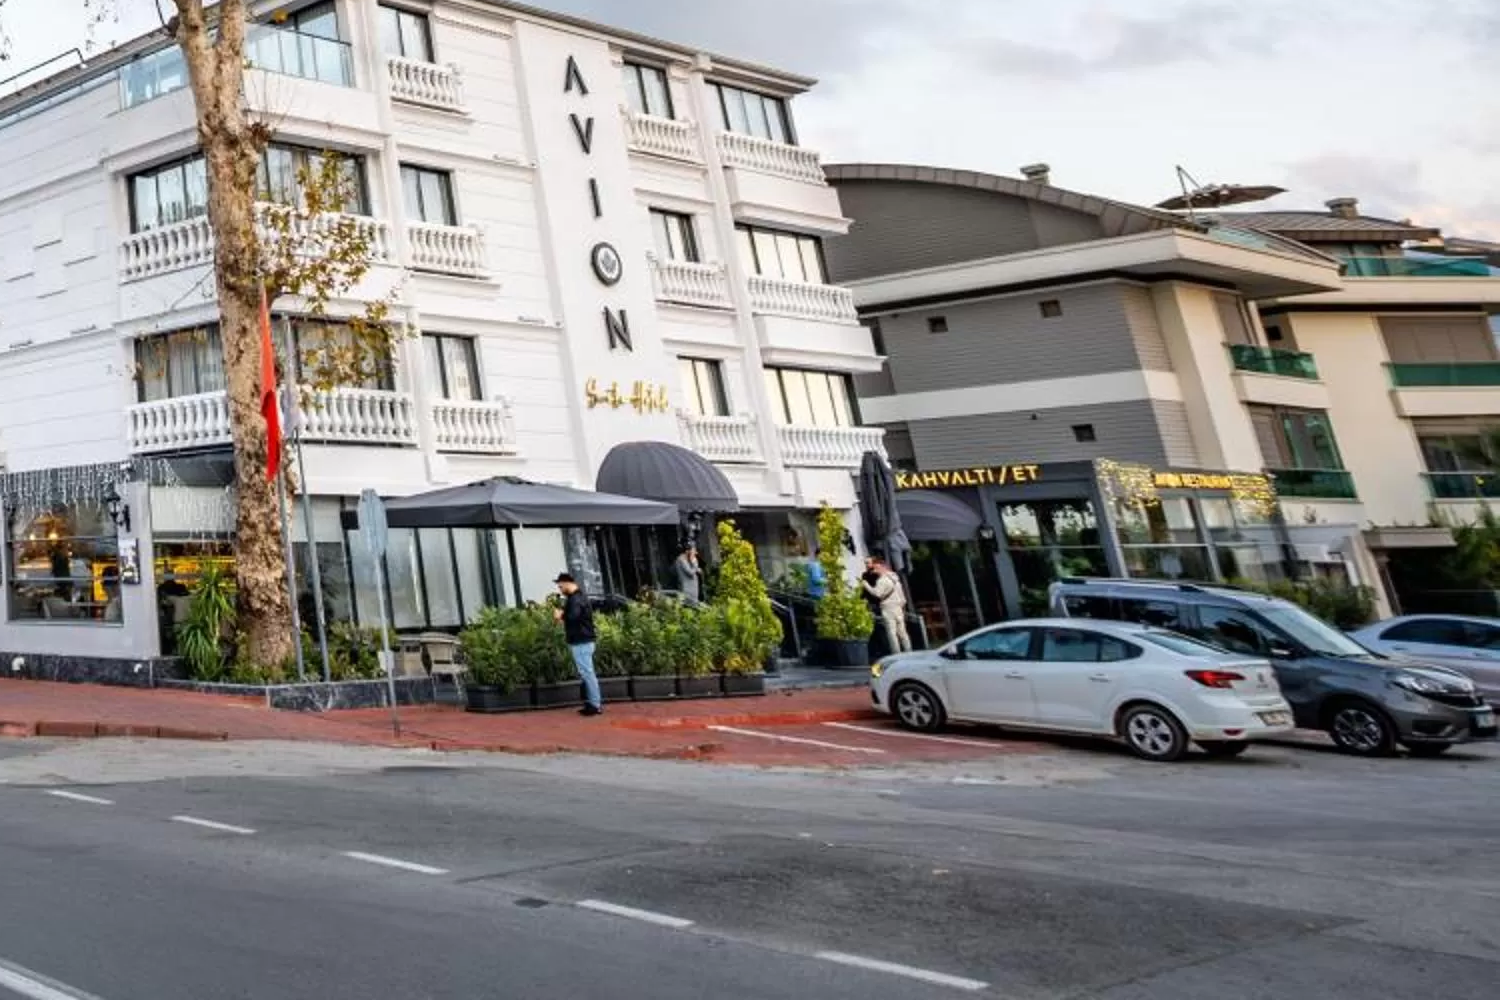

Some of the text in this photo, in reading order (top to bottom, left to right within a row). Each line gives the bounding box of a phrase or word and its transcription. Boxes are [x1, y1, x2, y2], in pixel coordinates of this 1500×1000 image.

[563, 54, 633, 352] AVION
[894, 469, 994, 489] KAHVALTI
[1013, 465, 1038, 482] ET
